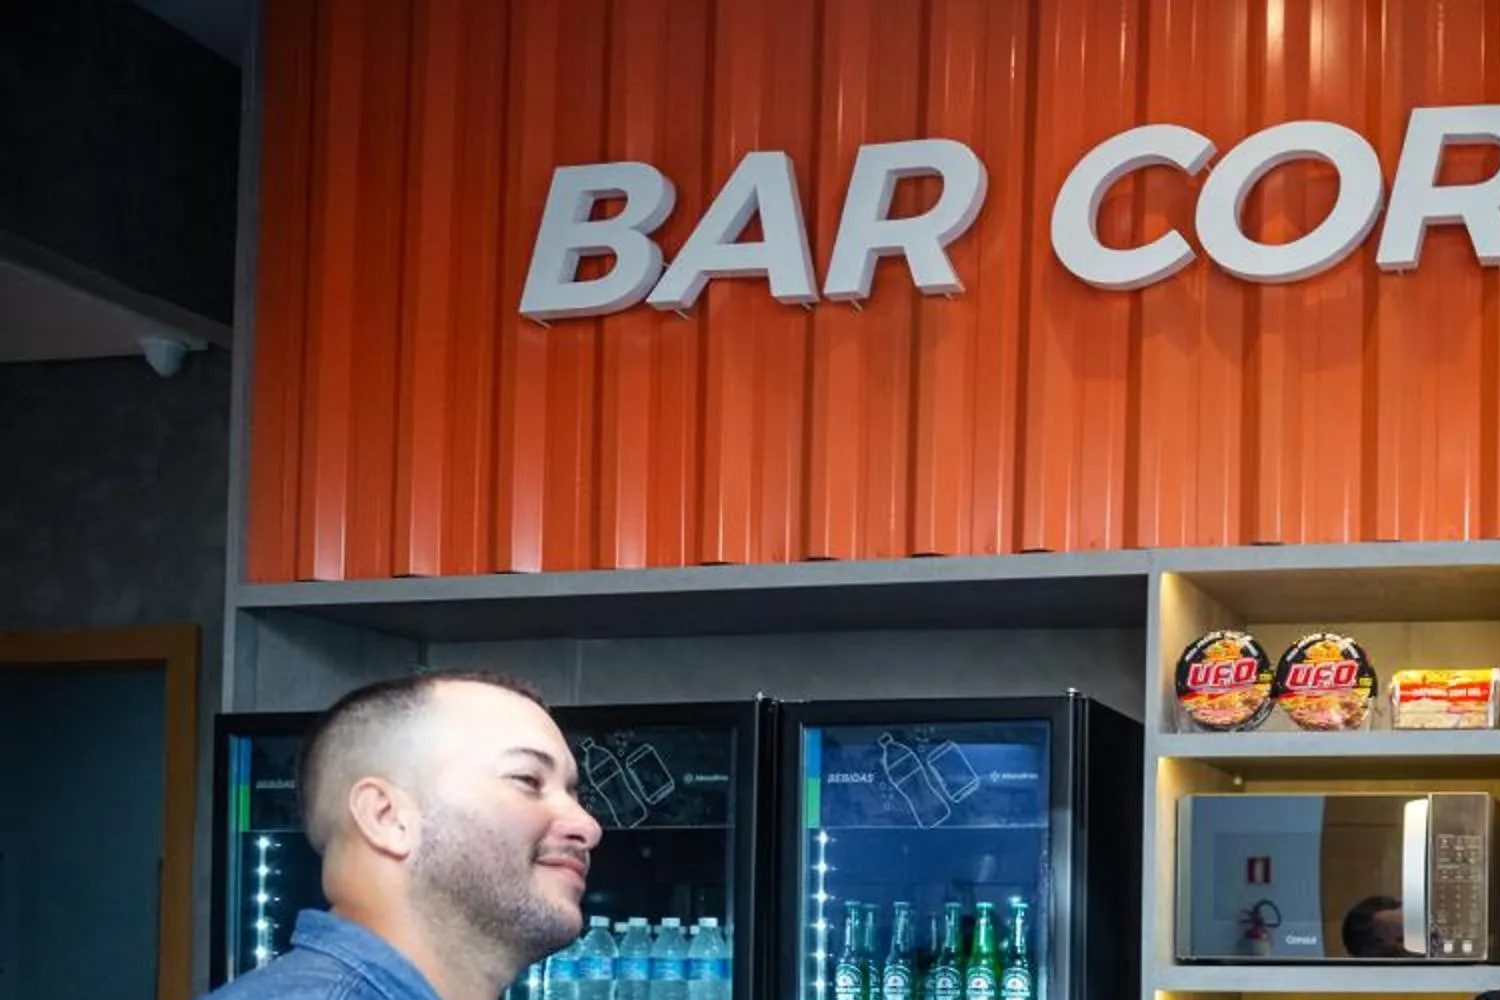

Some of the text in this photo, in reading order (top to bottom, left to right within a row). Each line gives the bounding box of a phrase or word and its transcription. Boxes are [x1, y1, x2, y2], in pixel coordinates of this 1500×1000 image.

[519, 140, 988, 320] BAR
[1188, 659, 1258, 688] UFO
[1286, 661, 1359, 689] UFO
